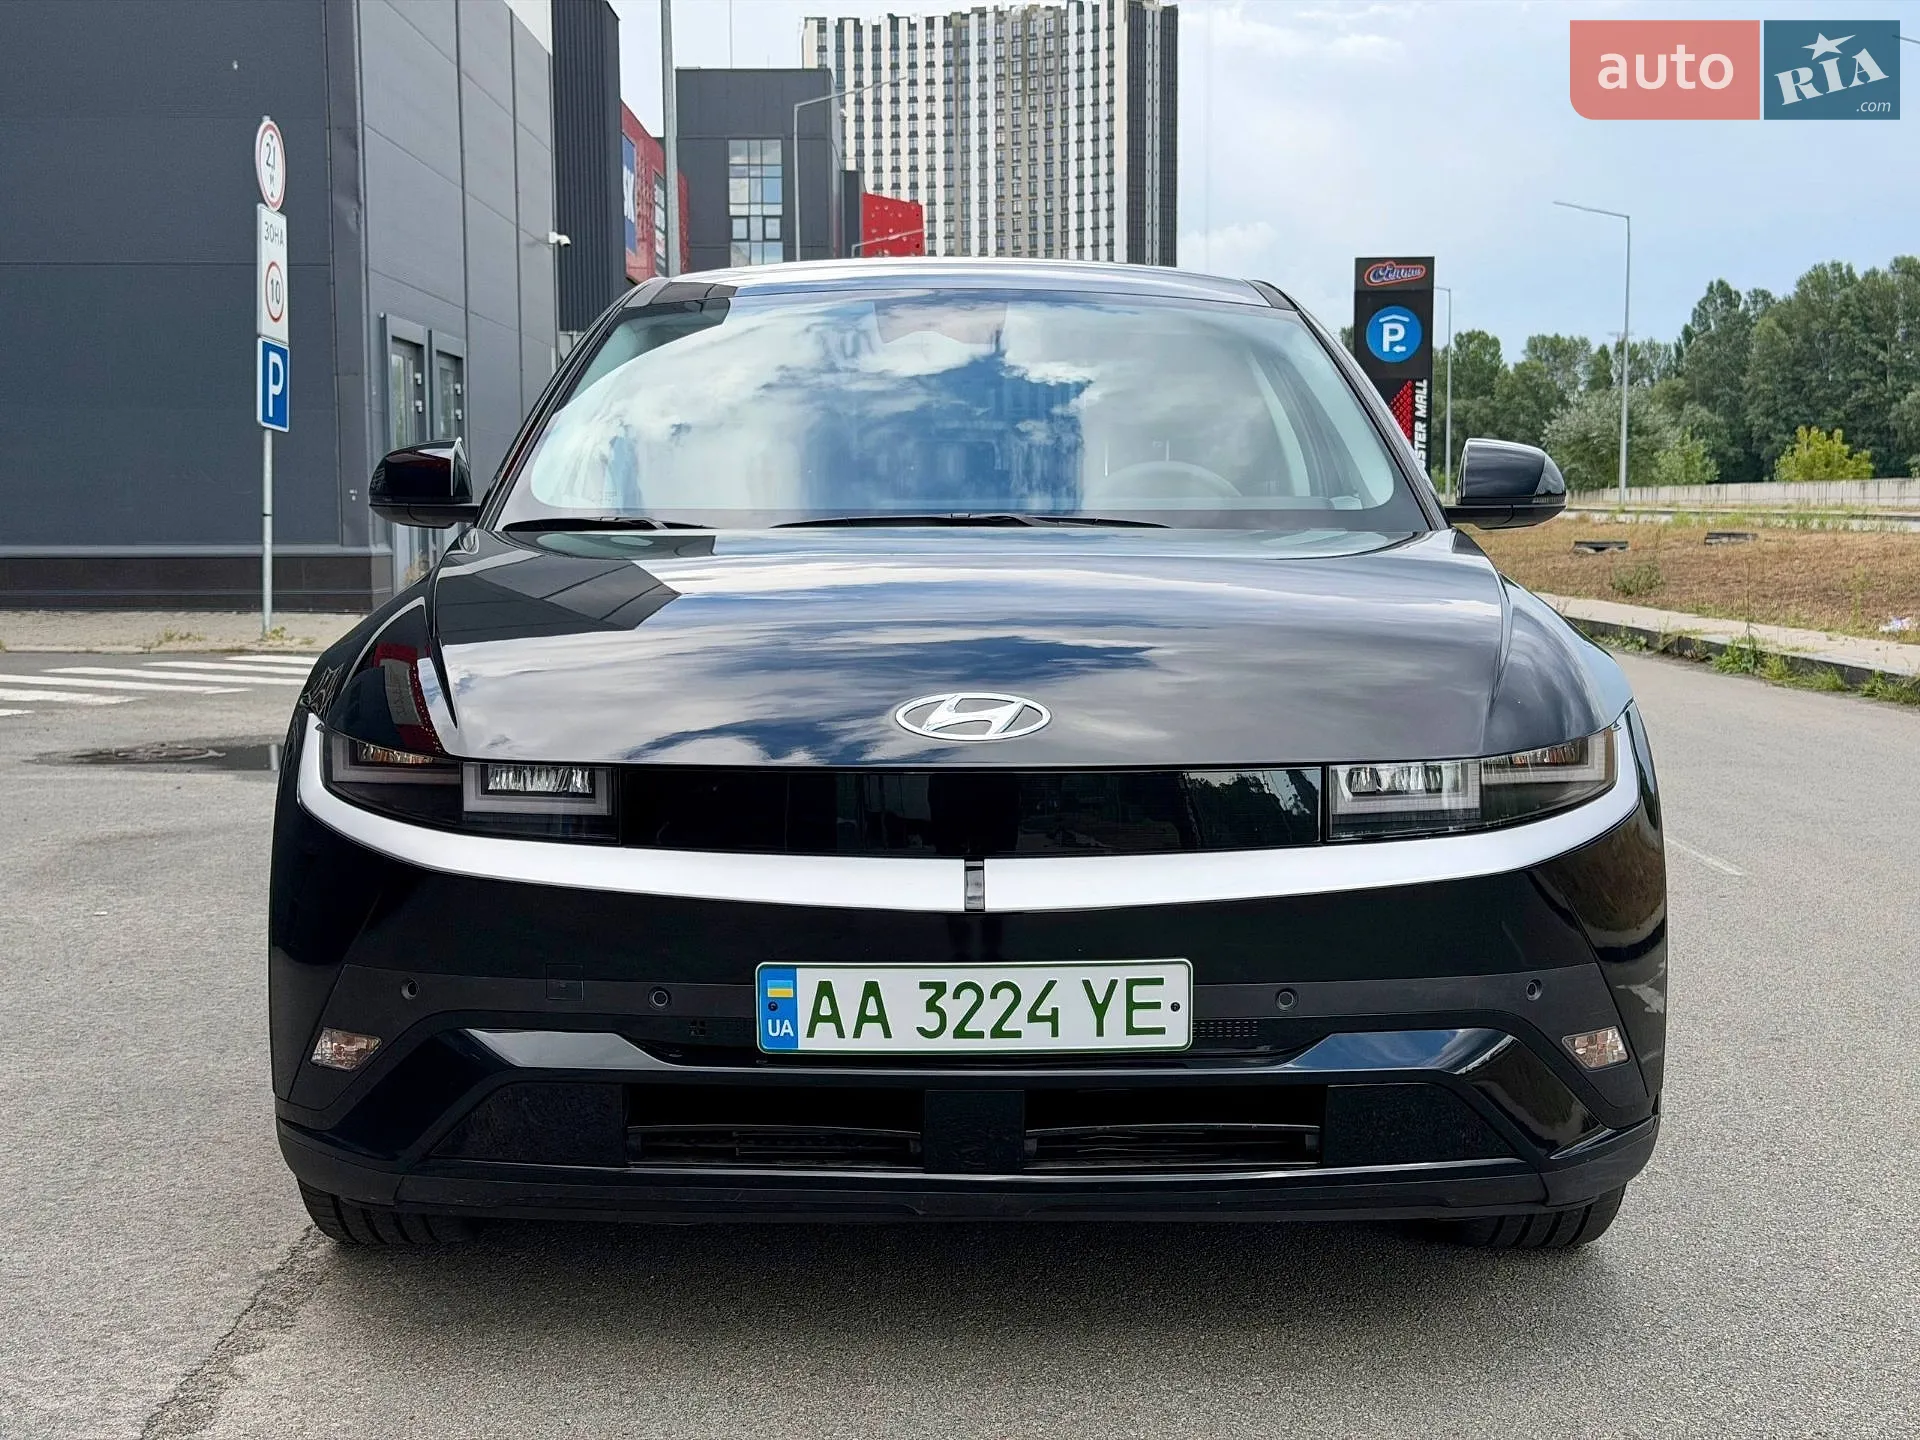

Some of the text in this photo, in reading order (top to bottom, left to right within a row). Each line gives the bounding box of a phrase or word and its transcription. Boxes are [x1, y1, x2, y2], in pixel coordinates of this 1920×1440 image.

[264, 221, 284, 248] ЗОНА
[270, 279, 281, 305] 10
[1382, 323, 1405, 353] P
[268, 350, 284, 418] P
[1414, 379, 1428, 418] MALL
[805, 977, 1167, 1040] AA 3224 YE
[767, 1018, 795, 1038] UA
